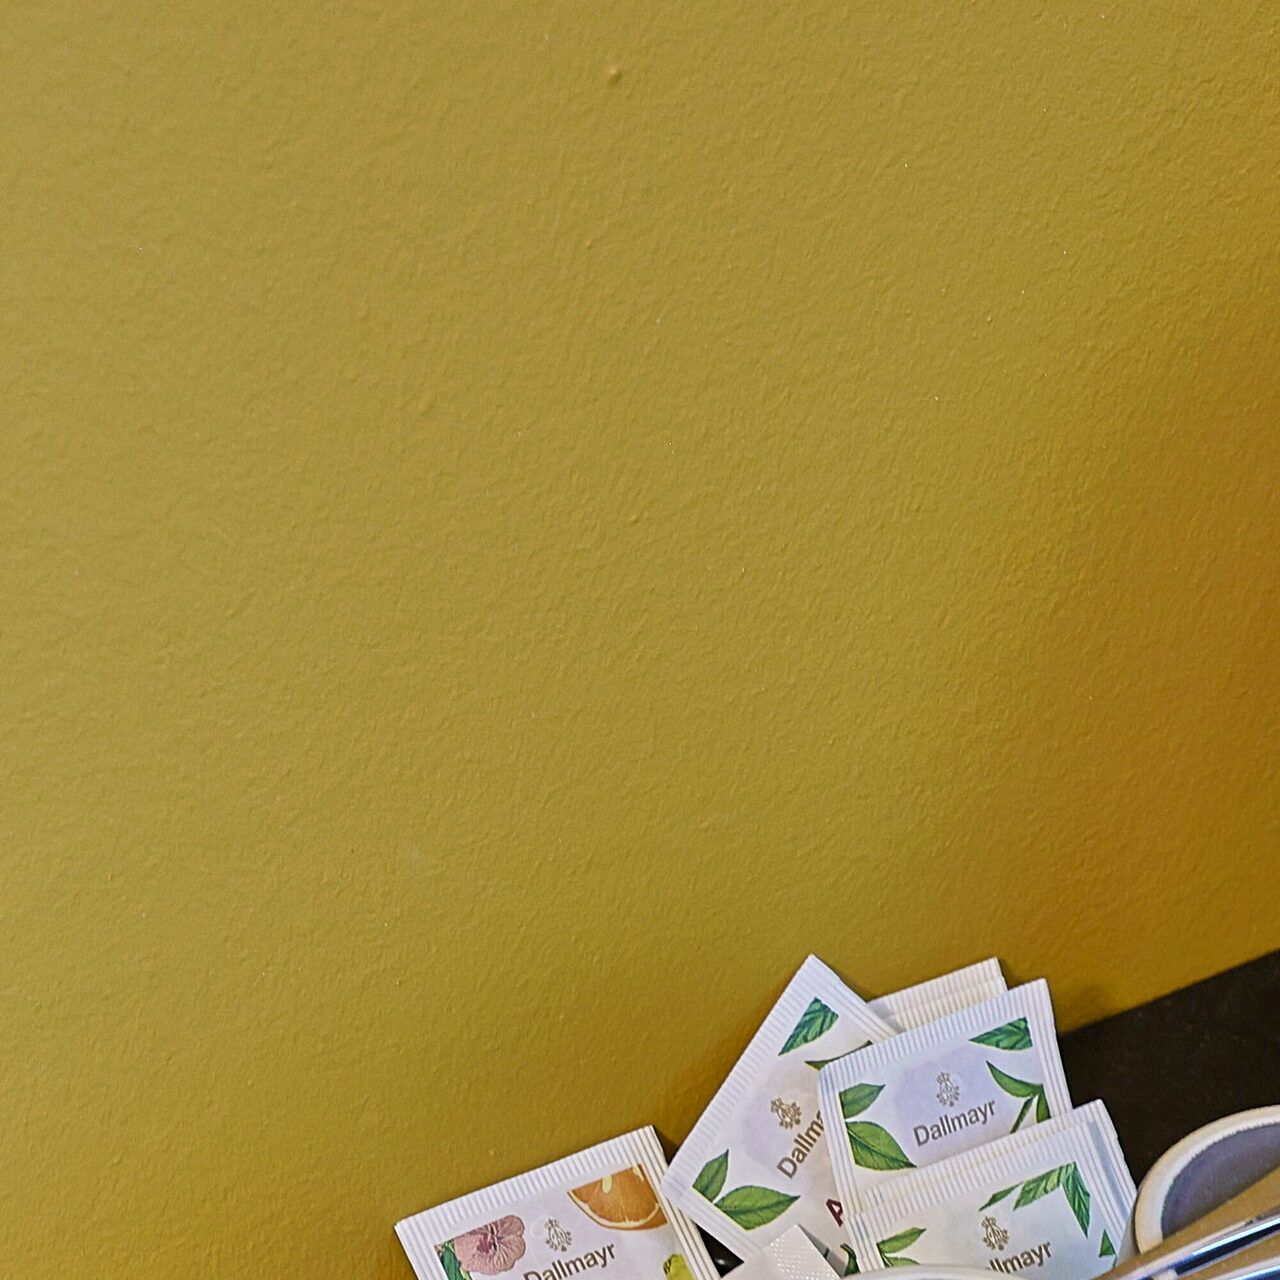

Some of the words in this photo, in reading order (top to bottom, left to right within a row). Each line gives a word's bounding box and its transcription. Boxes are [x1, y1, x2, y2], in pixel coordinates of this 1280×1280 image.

[777, 1110, 824, 1179] Dallm
[913, 1100, 996, 1147] Dallmayr
[987, 1242, 1052, 1274] llmayr
